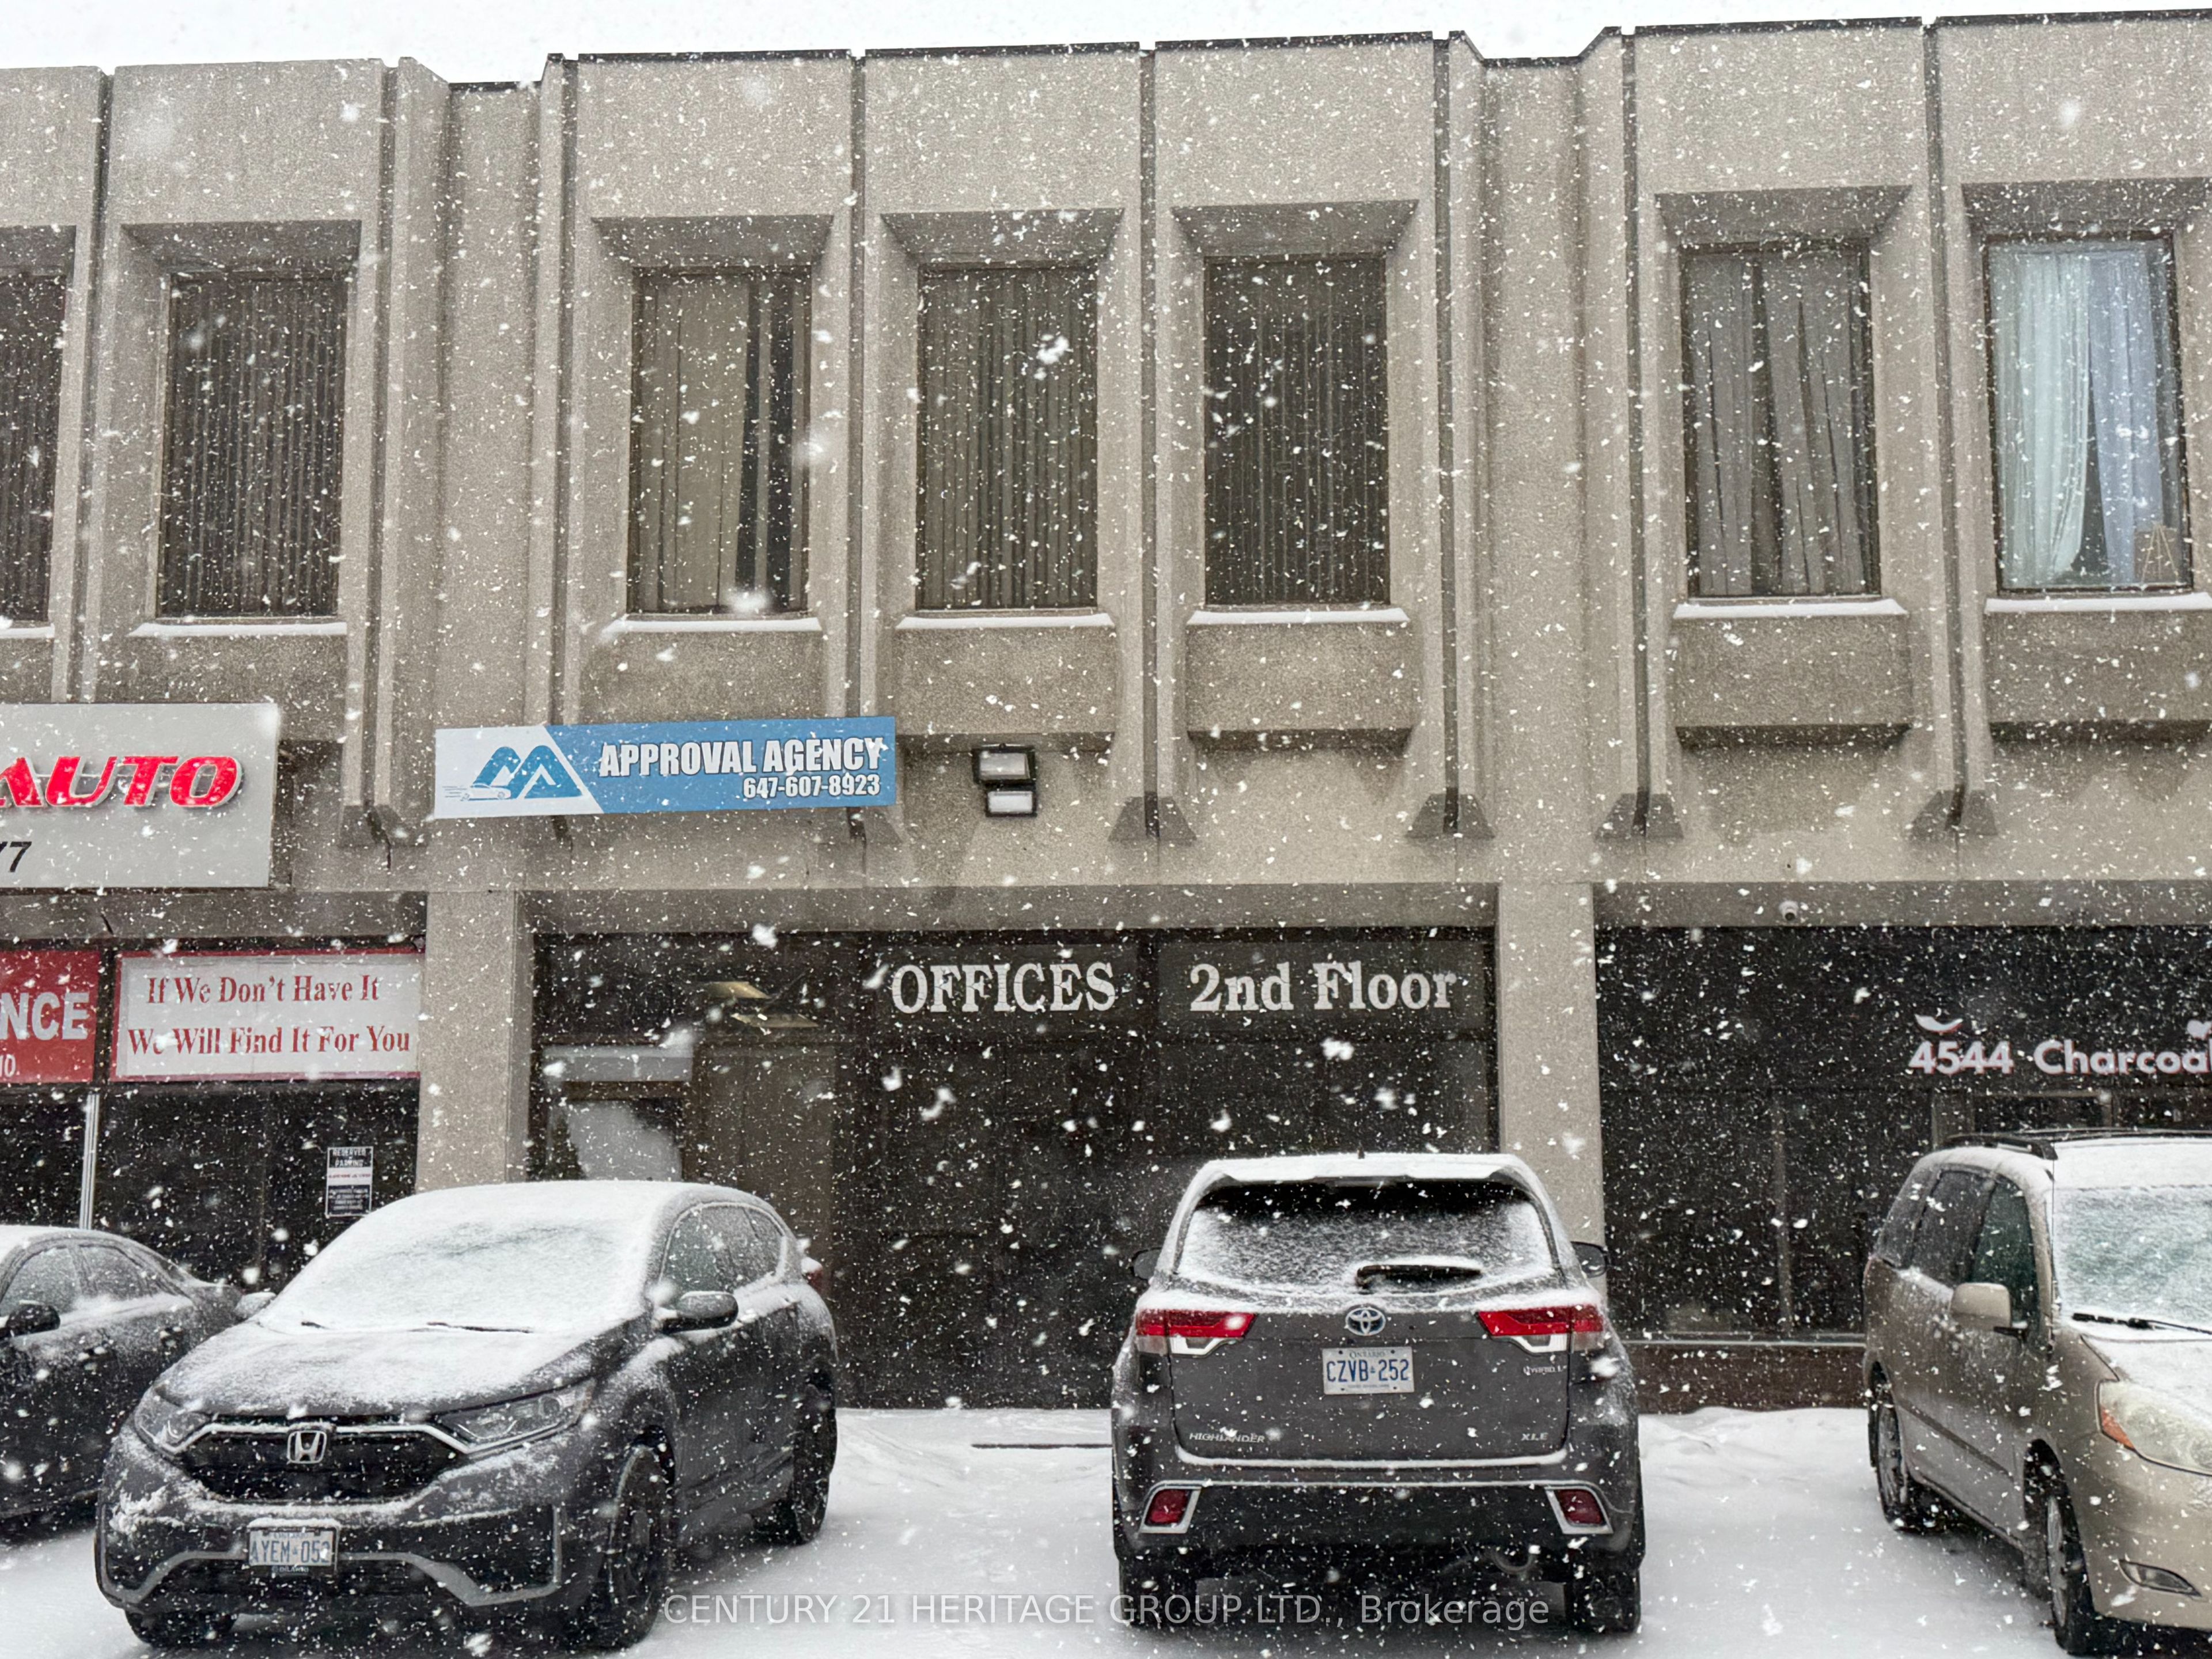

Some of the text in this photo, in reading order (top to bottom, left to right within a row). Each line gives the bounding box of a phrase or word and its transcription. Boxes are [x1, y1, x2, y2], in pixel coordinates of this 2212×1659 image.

[599, 737, 883, 778] APPROVAL AGENCY
[0, 756, 241, 807] AUTO
[743, 774, 880, 799] 647-607-8923
[147, 975, 379, 1003] If We Don't Have It
[891, 960, 1456, 1015] OFFICES 2nd Floor
[172, 1027, 221, 1055] Will
[229, 1027, 282, 1054] Find
[290, 1027, 310, 1052] It
[317, 1026, 359, 1052] For
[366, 1025, 410, 1052] You
[1908, 1040, 2014, 1074] 4544
[1189, 1433, 1265, 1443] HIGHLANDER
